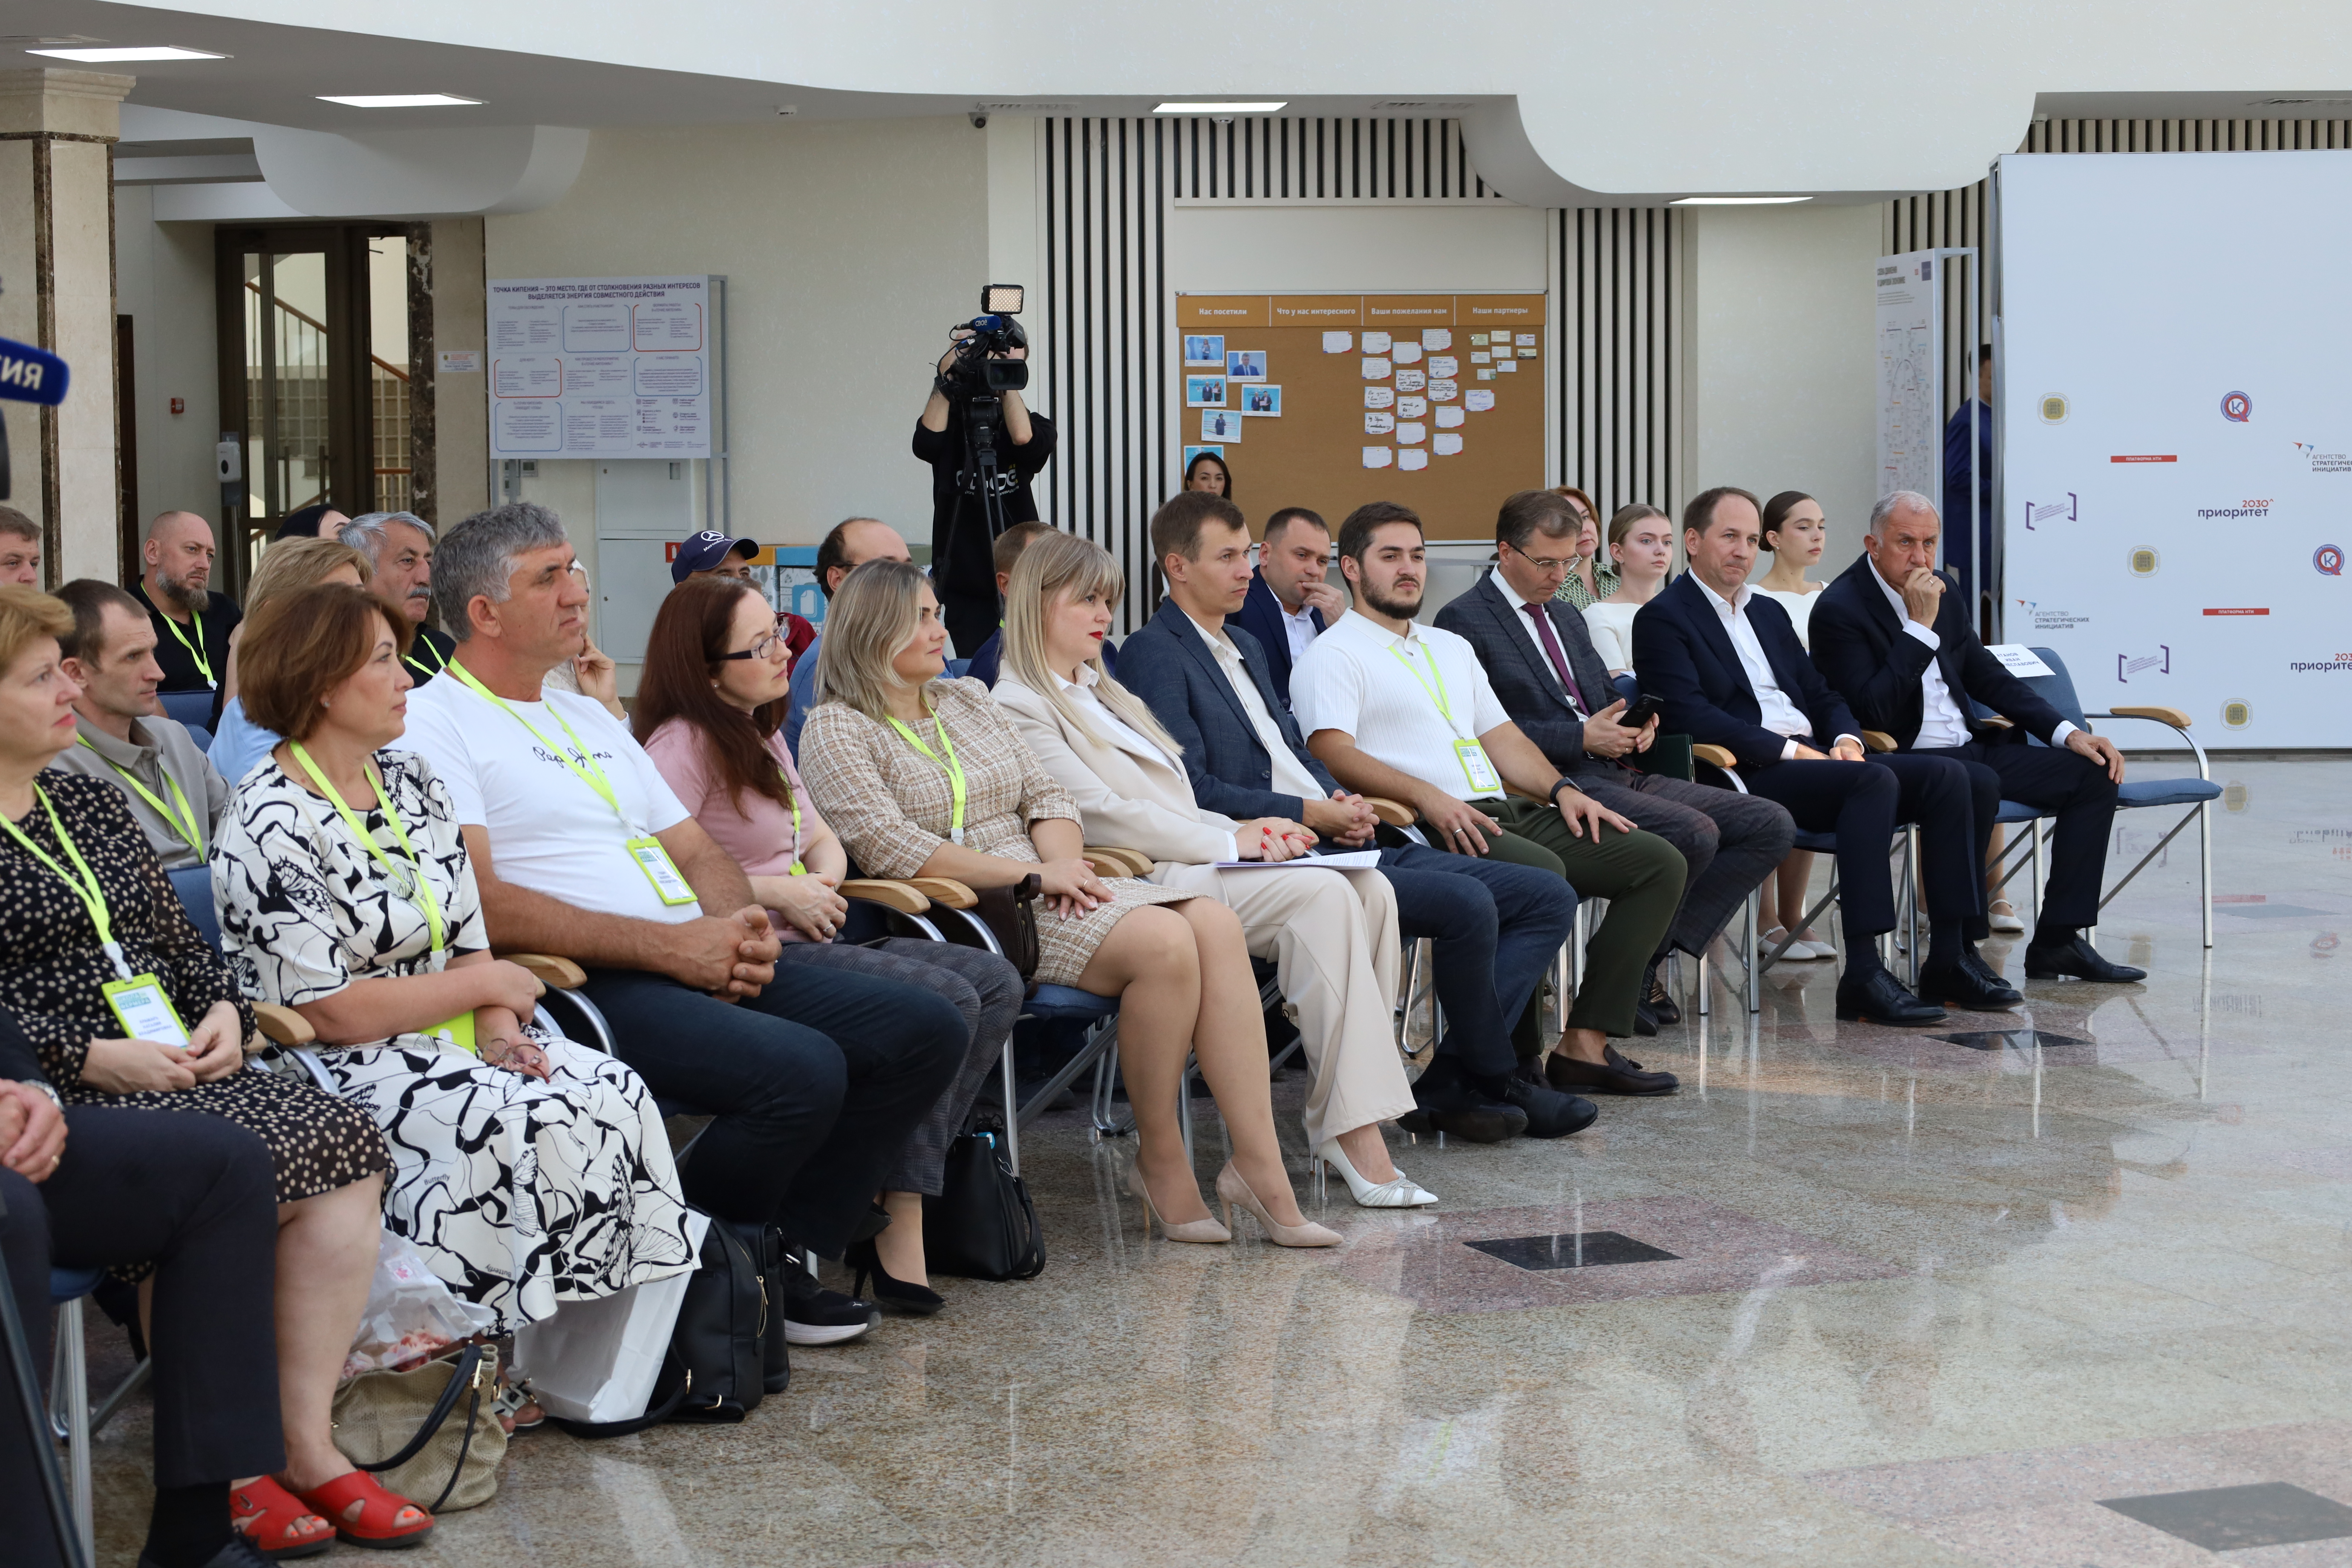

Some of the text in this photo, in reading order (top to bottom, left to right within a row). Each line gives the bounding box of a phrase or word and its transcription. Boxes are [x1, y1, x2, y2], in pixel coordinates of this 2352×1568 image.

[0, 354, 44, 390] ИЯ
[2198, 509, 2269, 519] приоритет
[645, 1158, 661, 1183] Butterfly
[424, 1173, 450, 1185] Butterfly
[485, 1263, 512, 1278] Butterfly
